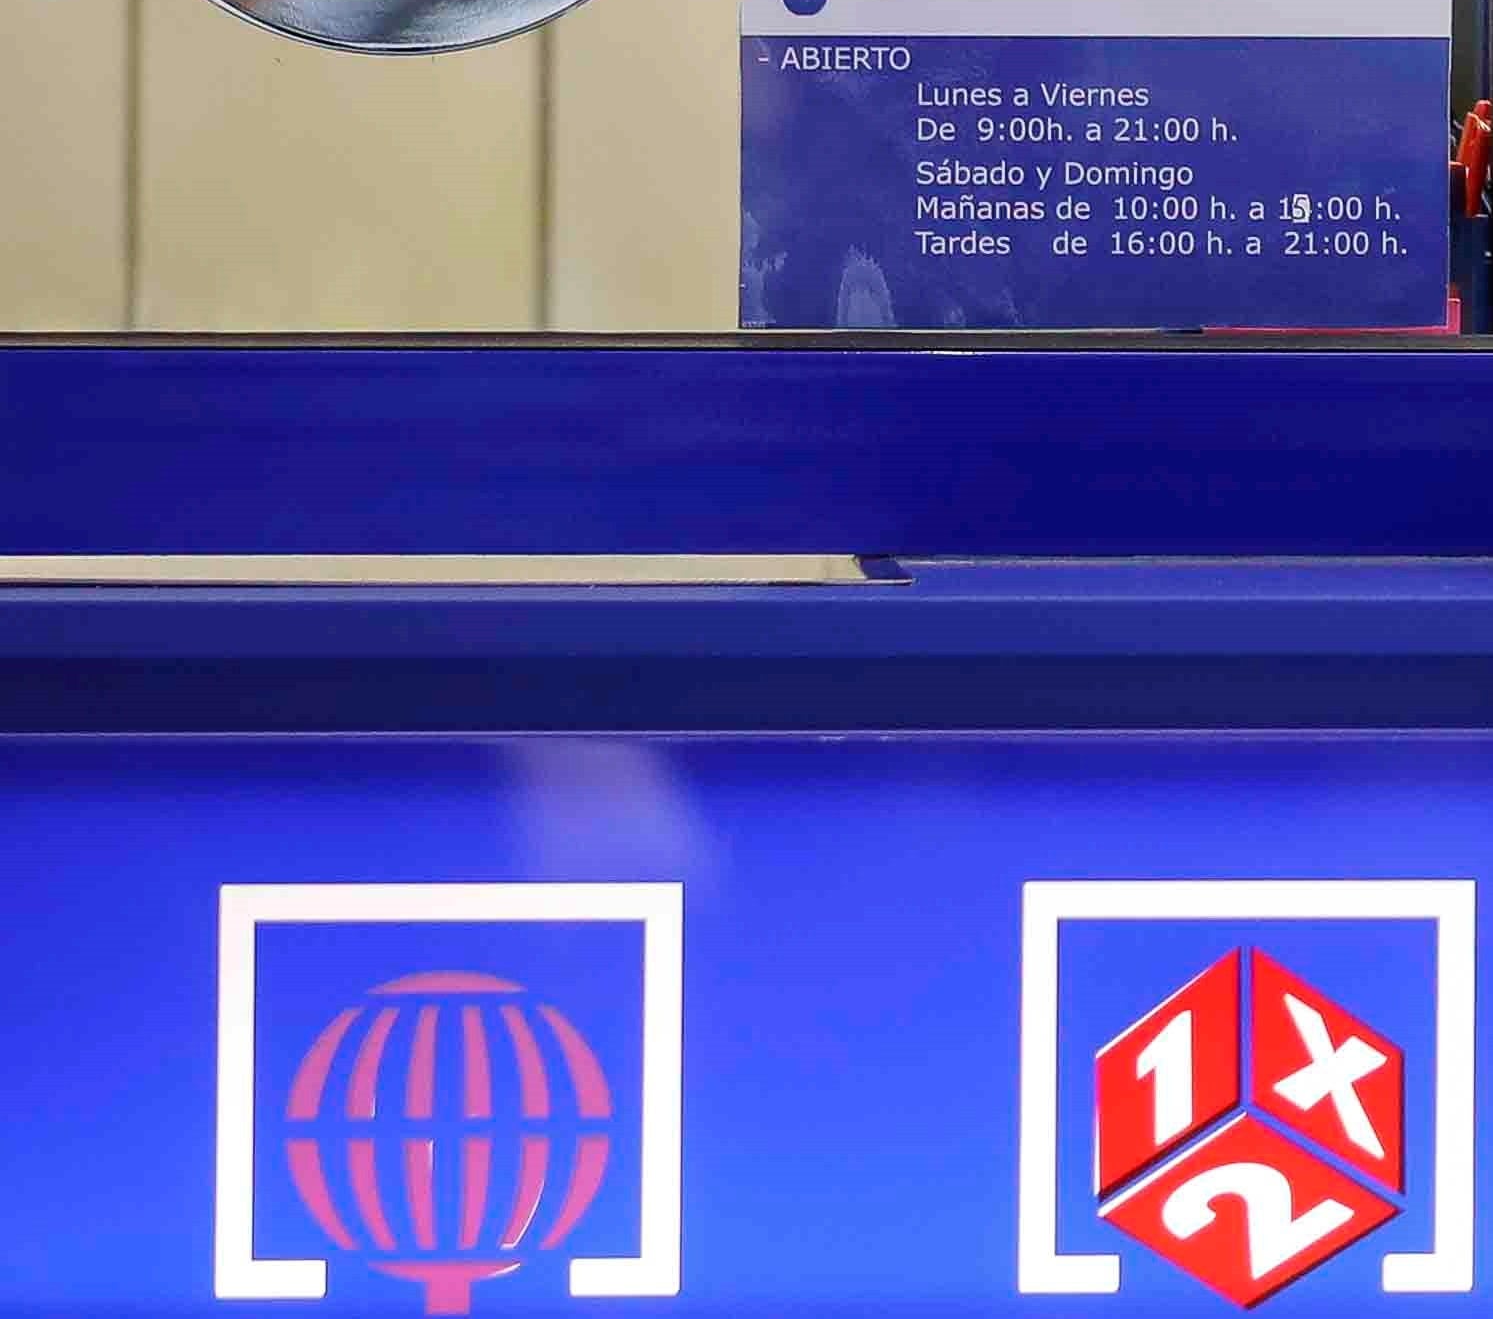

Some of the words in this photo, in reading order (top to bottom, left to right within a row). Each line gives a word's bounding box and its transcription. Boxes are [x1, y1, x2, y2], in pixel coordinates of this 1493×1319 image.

[780, 46, 911, 71] ABIERTO
[918, 82, 1002, 107] Lunes
[1013, 87, 1029, 107] a
[1040, 82, 1149, 107] Viernes
[917, 117, 956, 141] De
[977, 117, 1073, 142] 9:00h.
[1085, 122, 1101, 142] a
[1114, 117, 1200, 142] 21:00
[1212, 117, 1237, 142] h.
[916, 158, 1025, 185] Sábado
[1036, 166, 1053, 191] y
[1065, 161, 1194, 191] Domingo
[917, 194, 1045, 220] Mañanas
[1055, 195, 1091, 220] de
[1114, 196, 1198, 220] 10:00
[1210, 195, 1236, 220] h.
[1248, 201, 1265, 220] a
[1375, 195, 1401, 220] h.
[914, 230, 1011, 255] Tardes
[1052, 230, 1087, 255] de
[1111, 230, 1195, 255] 16:00
[1207, 230, 1232, 255] h.
[1245, 236, 1261, 255] a
[1284, 231, 1369, 255] 21:00
[1382, 230, 1407, 255] h.
